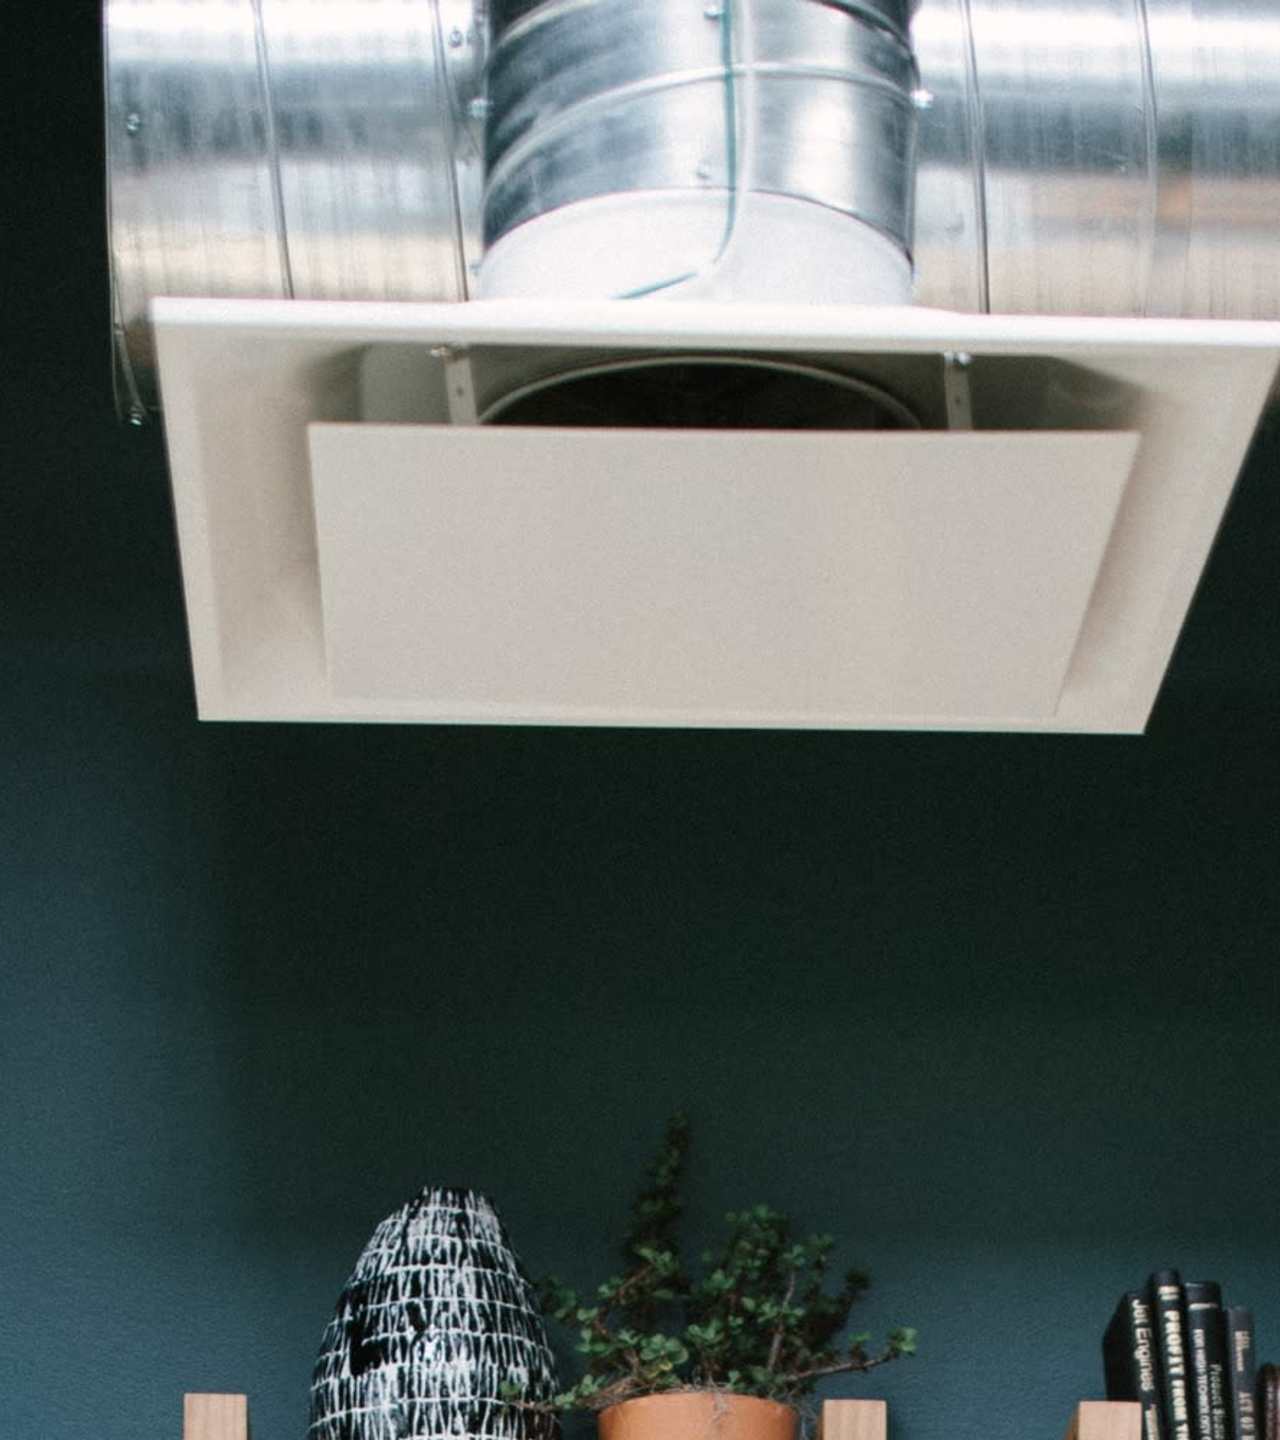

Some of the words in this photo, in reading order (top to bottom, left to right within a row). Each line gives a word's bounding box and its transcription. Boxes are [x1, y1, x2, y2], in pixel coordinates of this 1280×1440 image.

[1133, 1327, 1154, 1391] Engines
[1163, 1310, 1183, 1375] PROFIT
[1171, 1379, 1188, 1421] FROM
[1239, 1391, 1253, 1413] ACT
[1241, 1417, 1253, 1430] OF
